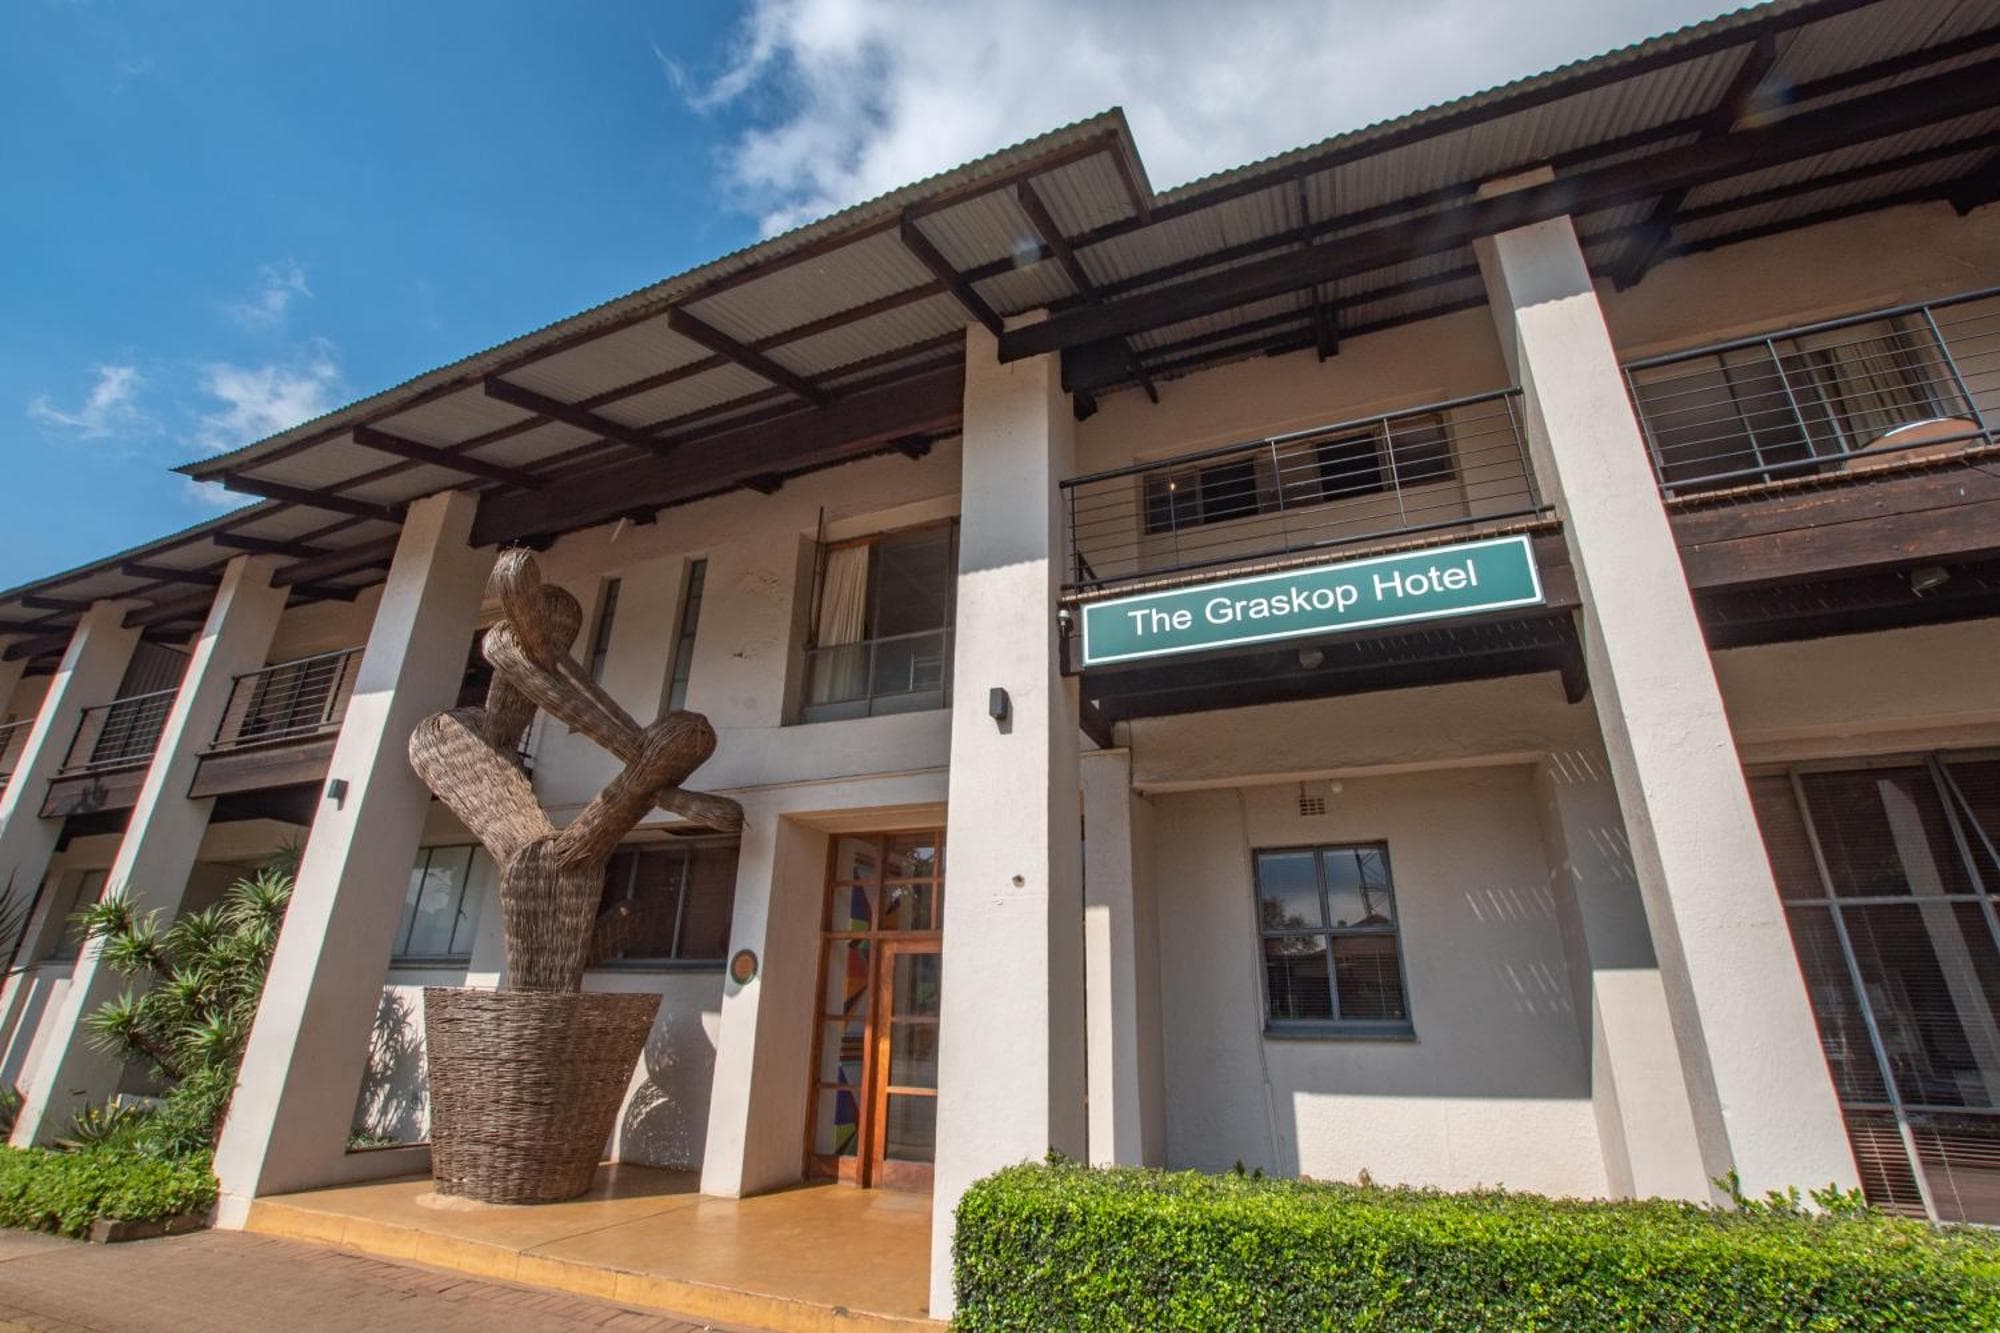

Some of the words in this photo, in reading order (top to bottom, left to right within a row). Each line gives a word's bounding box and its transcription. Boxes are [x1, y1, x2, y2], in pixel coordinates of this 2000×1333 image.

[1127, 607, 1193, 636] The
[1204, 584, 1359, 626] Graskop
[1372, 559, 1479, 601] Hotel
